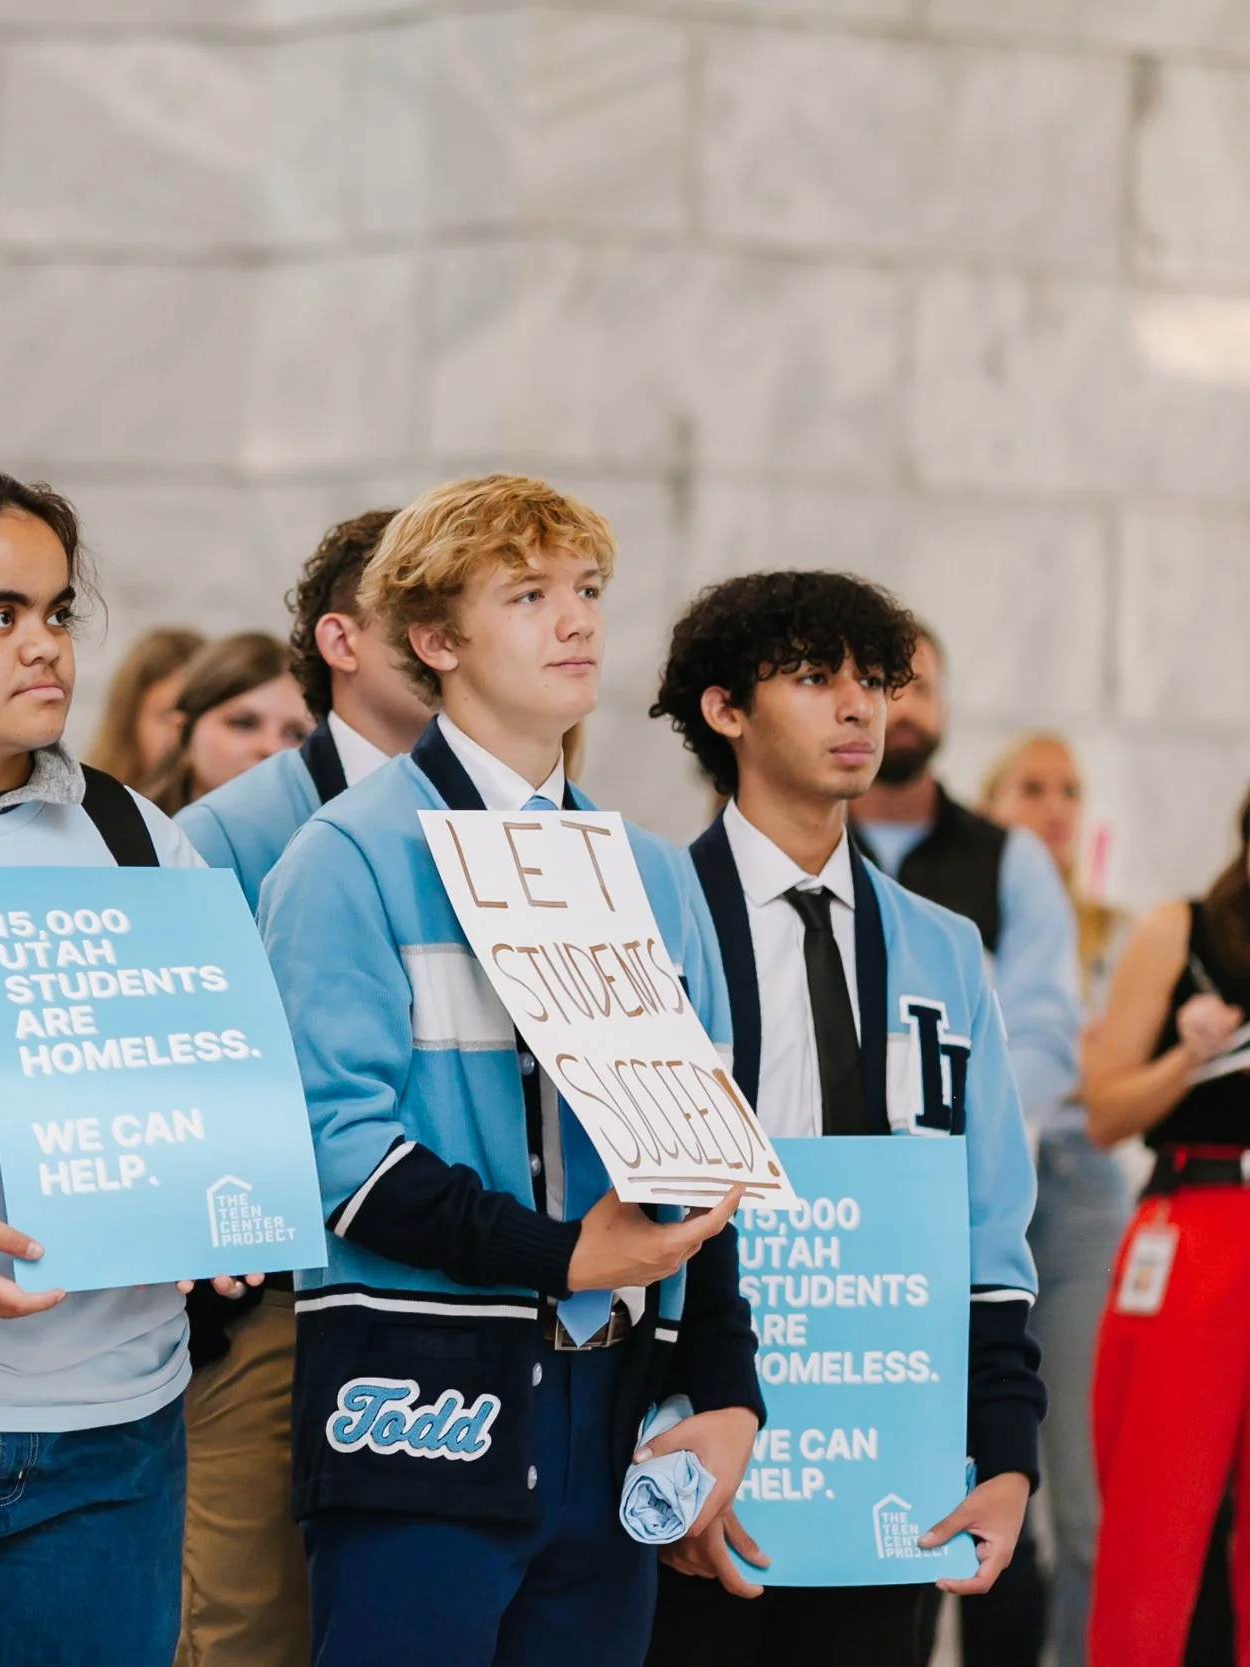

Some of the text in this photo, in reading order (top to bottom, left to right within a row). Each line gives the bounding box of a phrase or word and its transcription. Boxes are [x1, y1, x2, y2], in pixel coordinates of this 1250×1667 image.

[445, 818, 616, 913] LET
[4, 965, 229, 1005] STUDENTS
[491, 937, 684, 1025] STUDENTS
[15, 1004, 98, 1040] ARE
[18, 1029, 262, 1077] HOMELESS.
[31, 1108, 206, 1156] WE CAN
[555, 1053, 781, 1178] SUCCEED!
[38, 1155, 160, 1196] HELP.
[216, 1193, 248, 1207] THE
[218, 1205, 262, 1220] TEEN
[220, 1216, 284, 1234] CENTER
[221, 1227, 296, 1246] PROJECT
[738, 1236, 840, 1270] UTAH
[739, 1274, 929, 1308] STUDENTS
[755, 1350, 940, 1385] OMELESS.
[332, 1383, 495, 1453] Todd
[799, 1427, 878, 1461] CAN
[735, 1467, 835, 1501] HELP.
[880, 1512, 907, 1524] THE
[882, 1524, 919, 1536] TEEN
